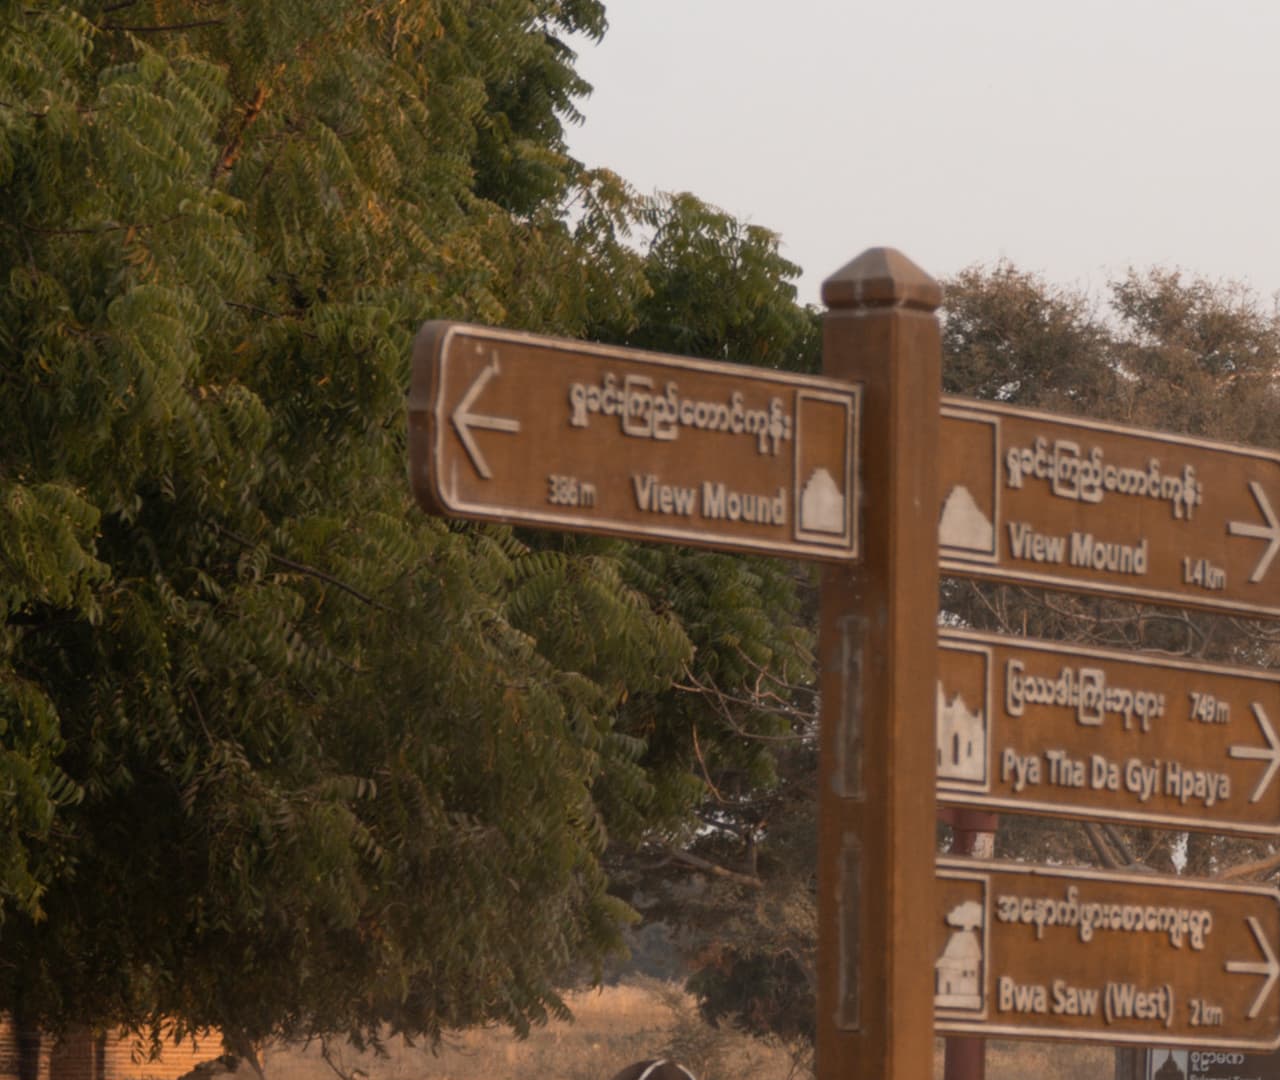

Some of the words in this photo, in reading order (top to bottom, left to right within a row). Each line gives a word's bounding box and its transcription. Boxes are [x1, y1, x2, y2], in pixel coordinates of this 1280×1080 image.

[632, 473, 698, 516] View
[702, 480, 787, 526] Mound
[1008, 520, 1066, 563] View
[1071, 531, 1148, 576] Mound
[1003, 747, 1041, 792] Pya
[1045, 748, 1086, 788] Tha
[1090, 755, 1120, 791] Da
[1125, 758, 1160, 802] Gyi
[1165, 762, 1232, 807] Hpaya
[998, 977, 1047, 1016] Bwa
[1052, 979, 1099, 1018] Saw
[1104, 982, 1175, 1028] (West)
